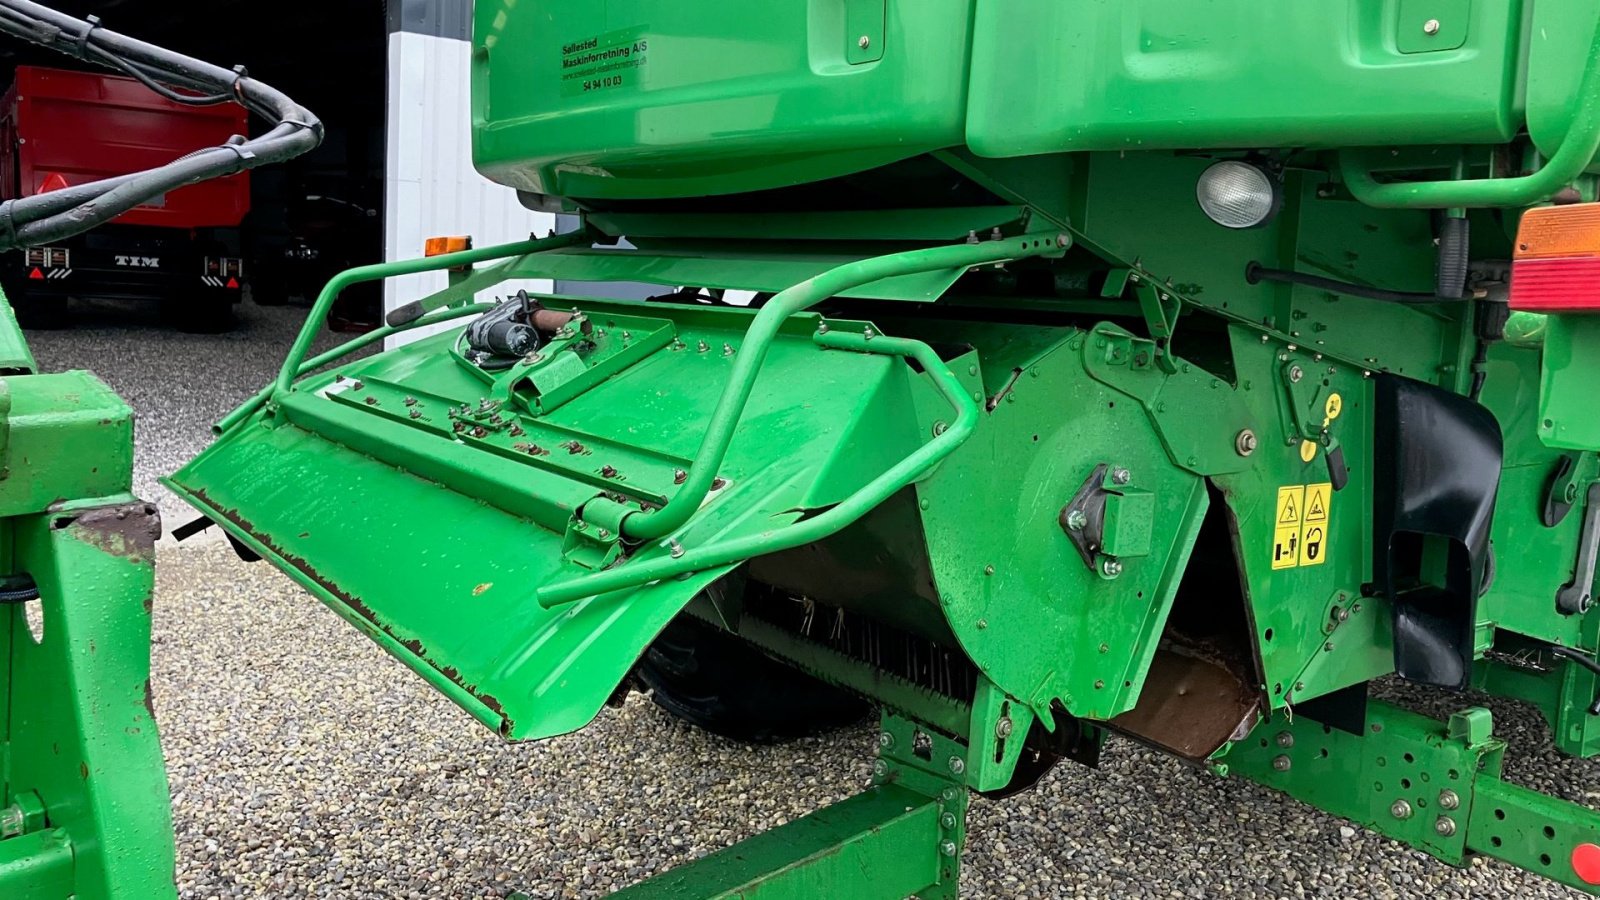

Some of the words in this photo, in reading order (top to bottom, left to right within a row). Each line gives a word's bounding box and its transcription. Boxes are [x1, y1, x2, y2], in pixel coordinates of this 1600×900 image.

[562, 47, 629, 68] Maskinforretning
[632, 41, 647, 54] A/S
[583, 81, 591, 91] 54
[592, 80, 601, 89] 94
[603, 78, 612, 87] 10
[613, 76, 622, 86] 03
[115, 255, 159, 268] TIM
